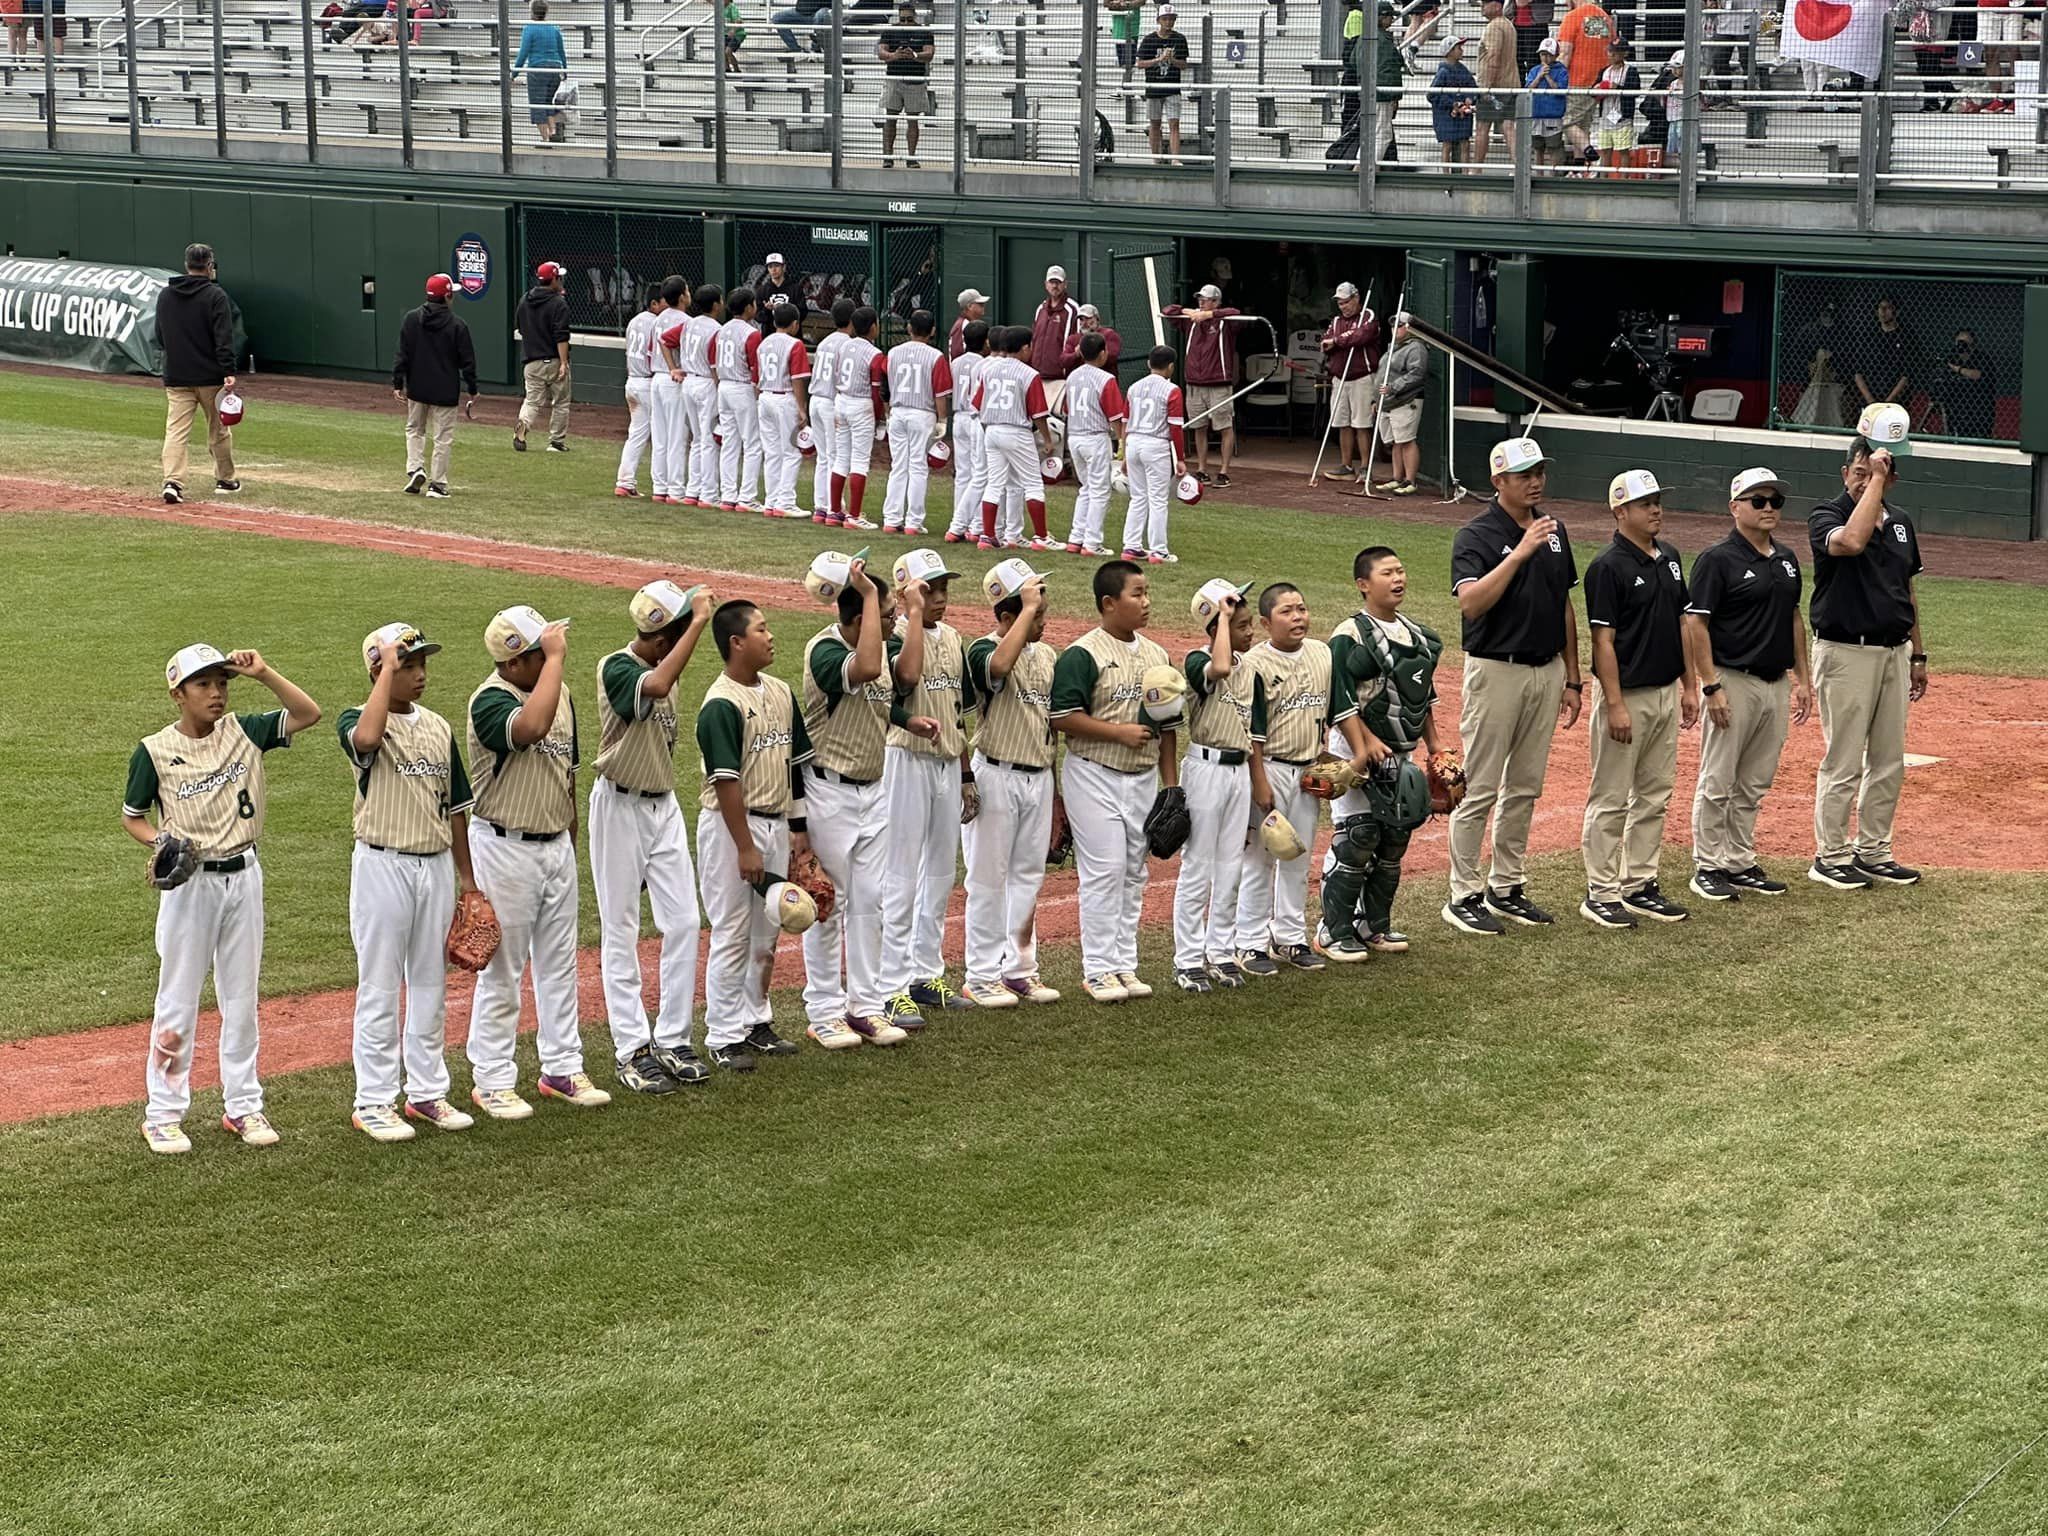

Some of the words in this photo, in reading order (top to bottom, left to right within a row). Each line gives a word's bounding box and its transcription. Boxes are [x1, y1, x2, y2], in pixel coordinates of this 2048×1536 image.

[888, 201, 917, 213] HOME
[812, 227, 869, 241] LITTLELEAGUE.ORG
[457, 251, 486, 262] WORLD
[458, 262, 485, 273] SERIES
[61, 265, 168, 302] LEAGUE
[31, 291, 60, 333] UP
[64, 295, 140, 342] GRANT
[629, 329, 645, 360] 22
[685, 333, 701, 361] 17
[718, 339, 735, 368] 18
[1678, 337, 1706, 351] ESPN
[816, 351, 834, 381] 15
[841, 358, 855, 387] 9
[896, 363, 922, 394] 21
[986, 377, 1016, 410] 25
[1069, 386, 1090, 418] 14
[1132, 397, 1155, 429] 12
[237, 788, 255, 819] 8
